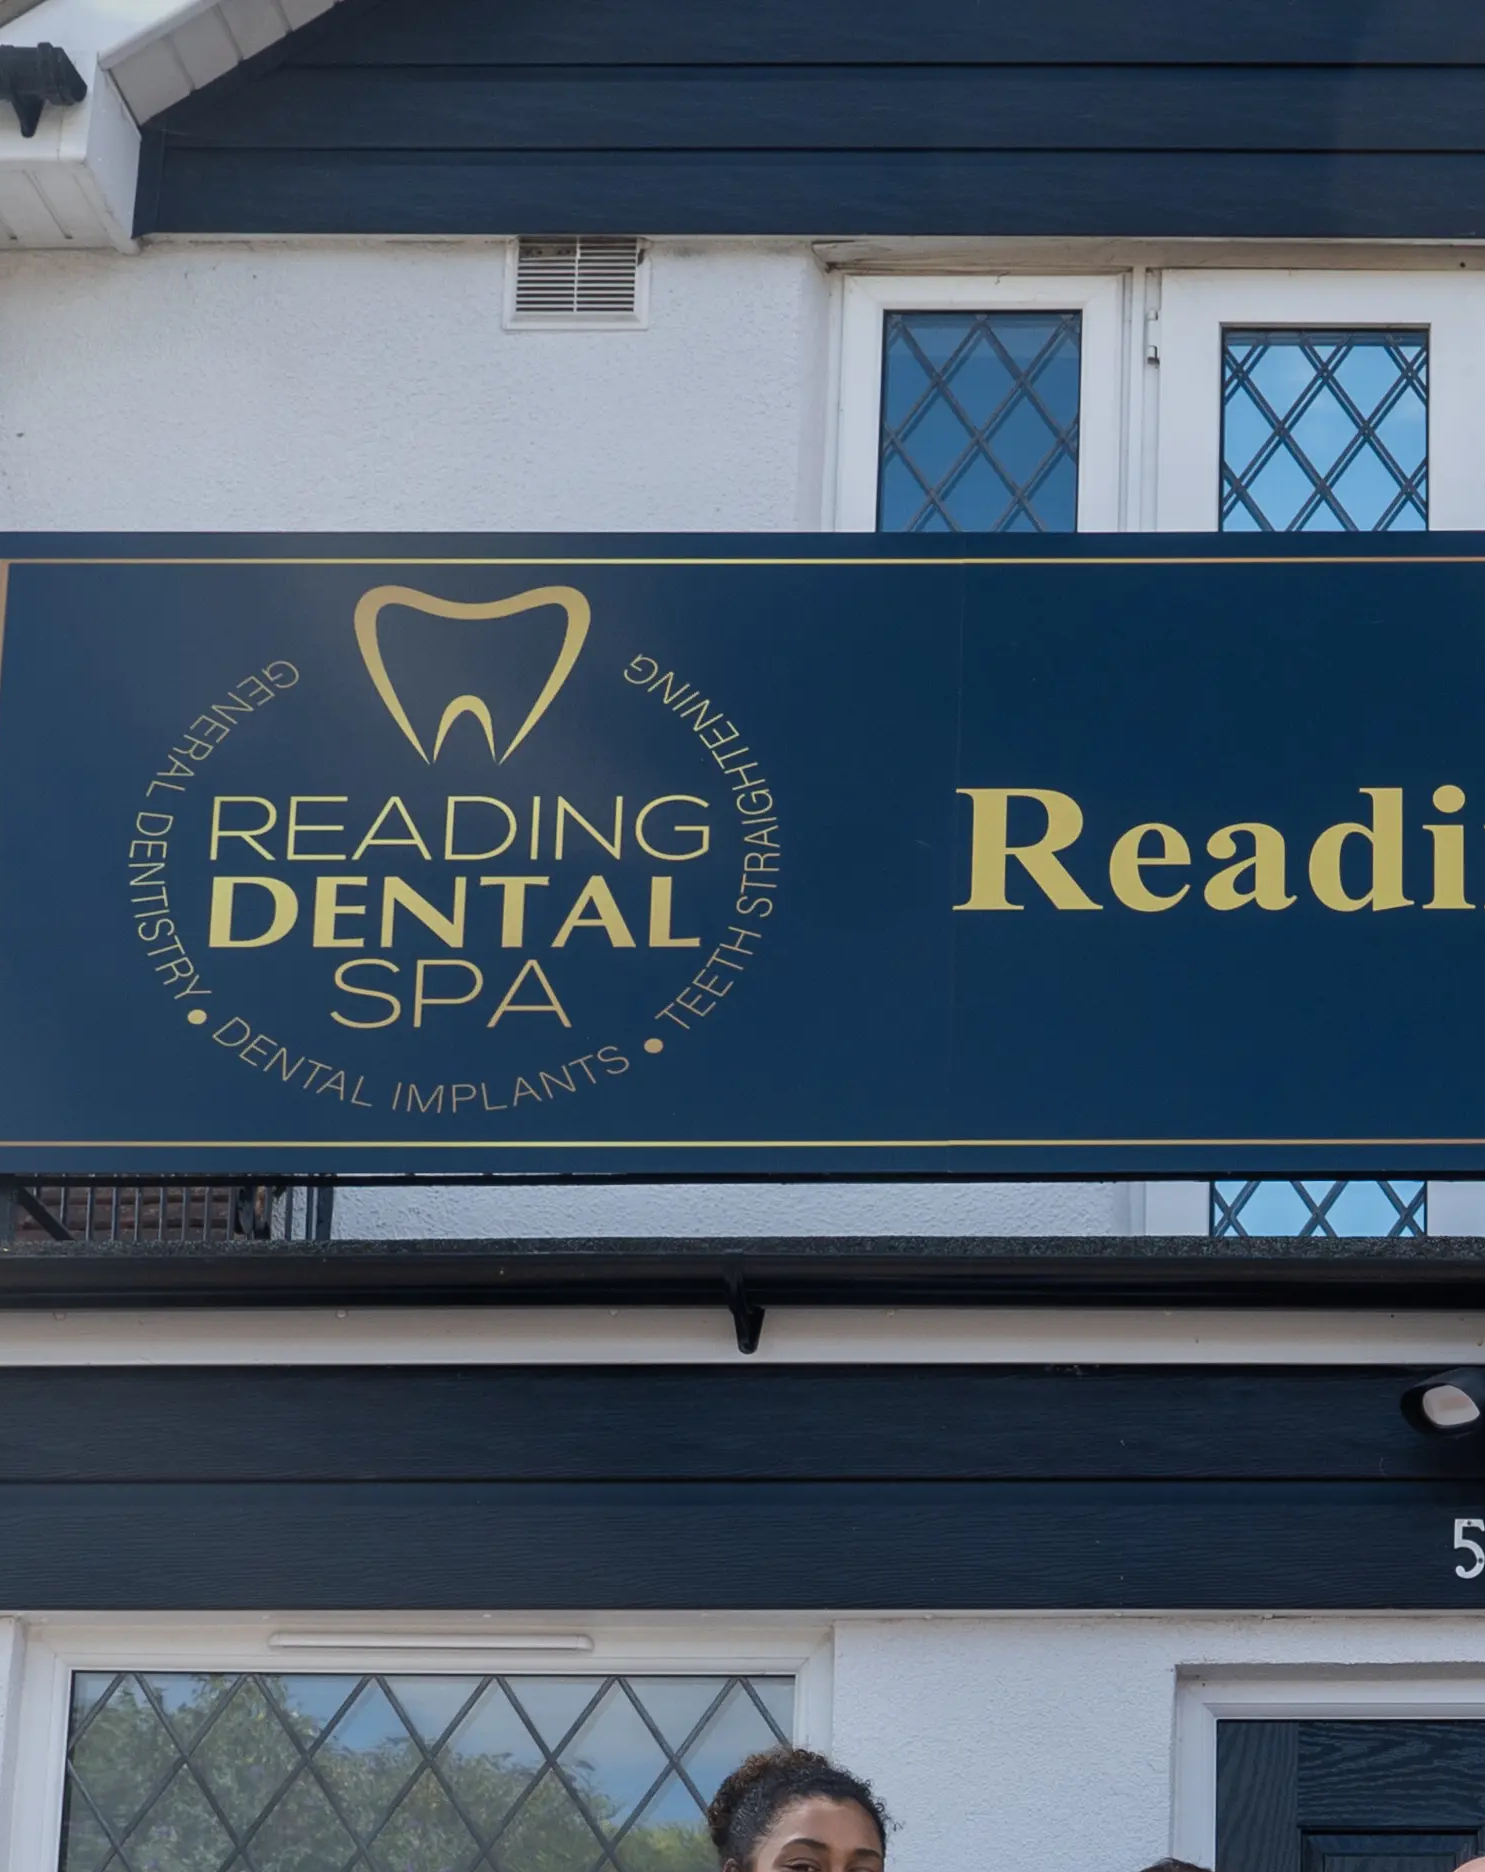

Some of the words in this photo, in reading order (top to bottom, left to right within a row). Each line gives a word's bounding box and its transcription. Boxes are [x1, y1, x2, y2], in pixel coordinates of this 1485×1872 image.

[146, 660, 300, 798] GENERAL
[209, 793, 711, 862] READING
[622, 652, 781, 918] STRAIGHTENING
[127, 811, 213, 1000] DENTISTRY
[207, 875, 701, 949] DENTAL
[329, 957, 573, 1030] SPA
[653, 925, 762, 1031] TEETH
[212, 1016, 373, 1109] DENTAL
[391, 1045, 630, 1114] IMPLANTS
